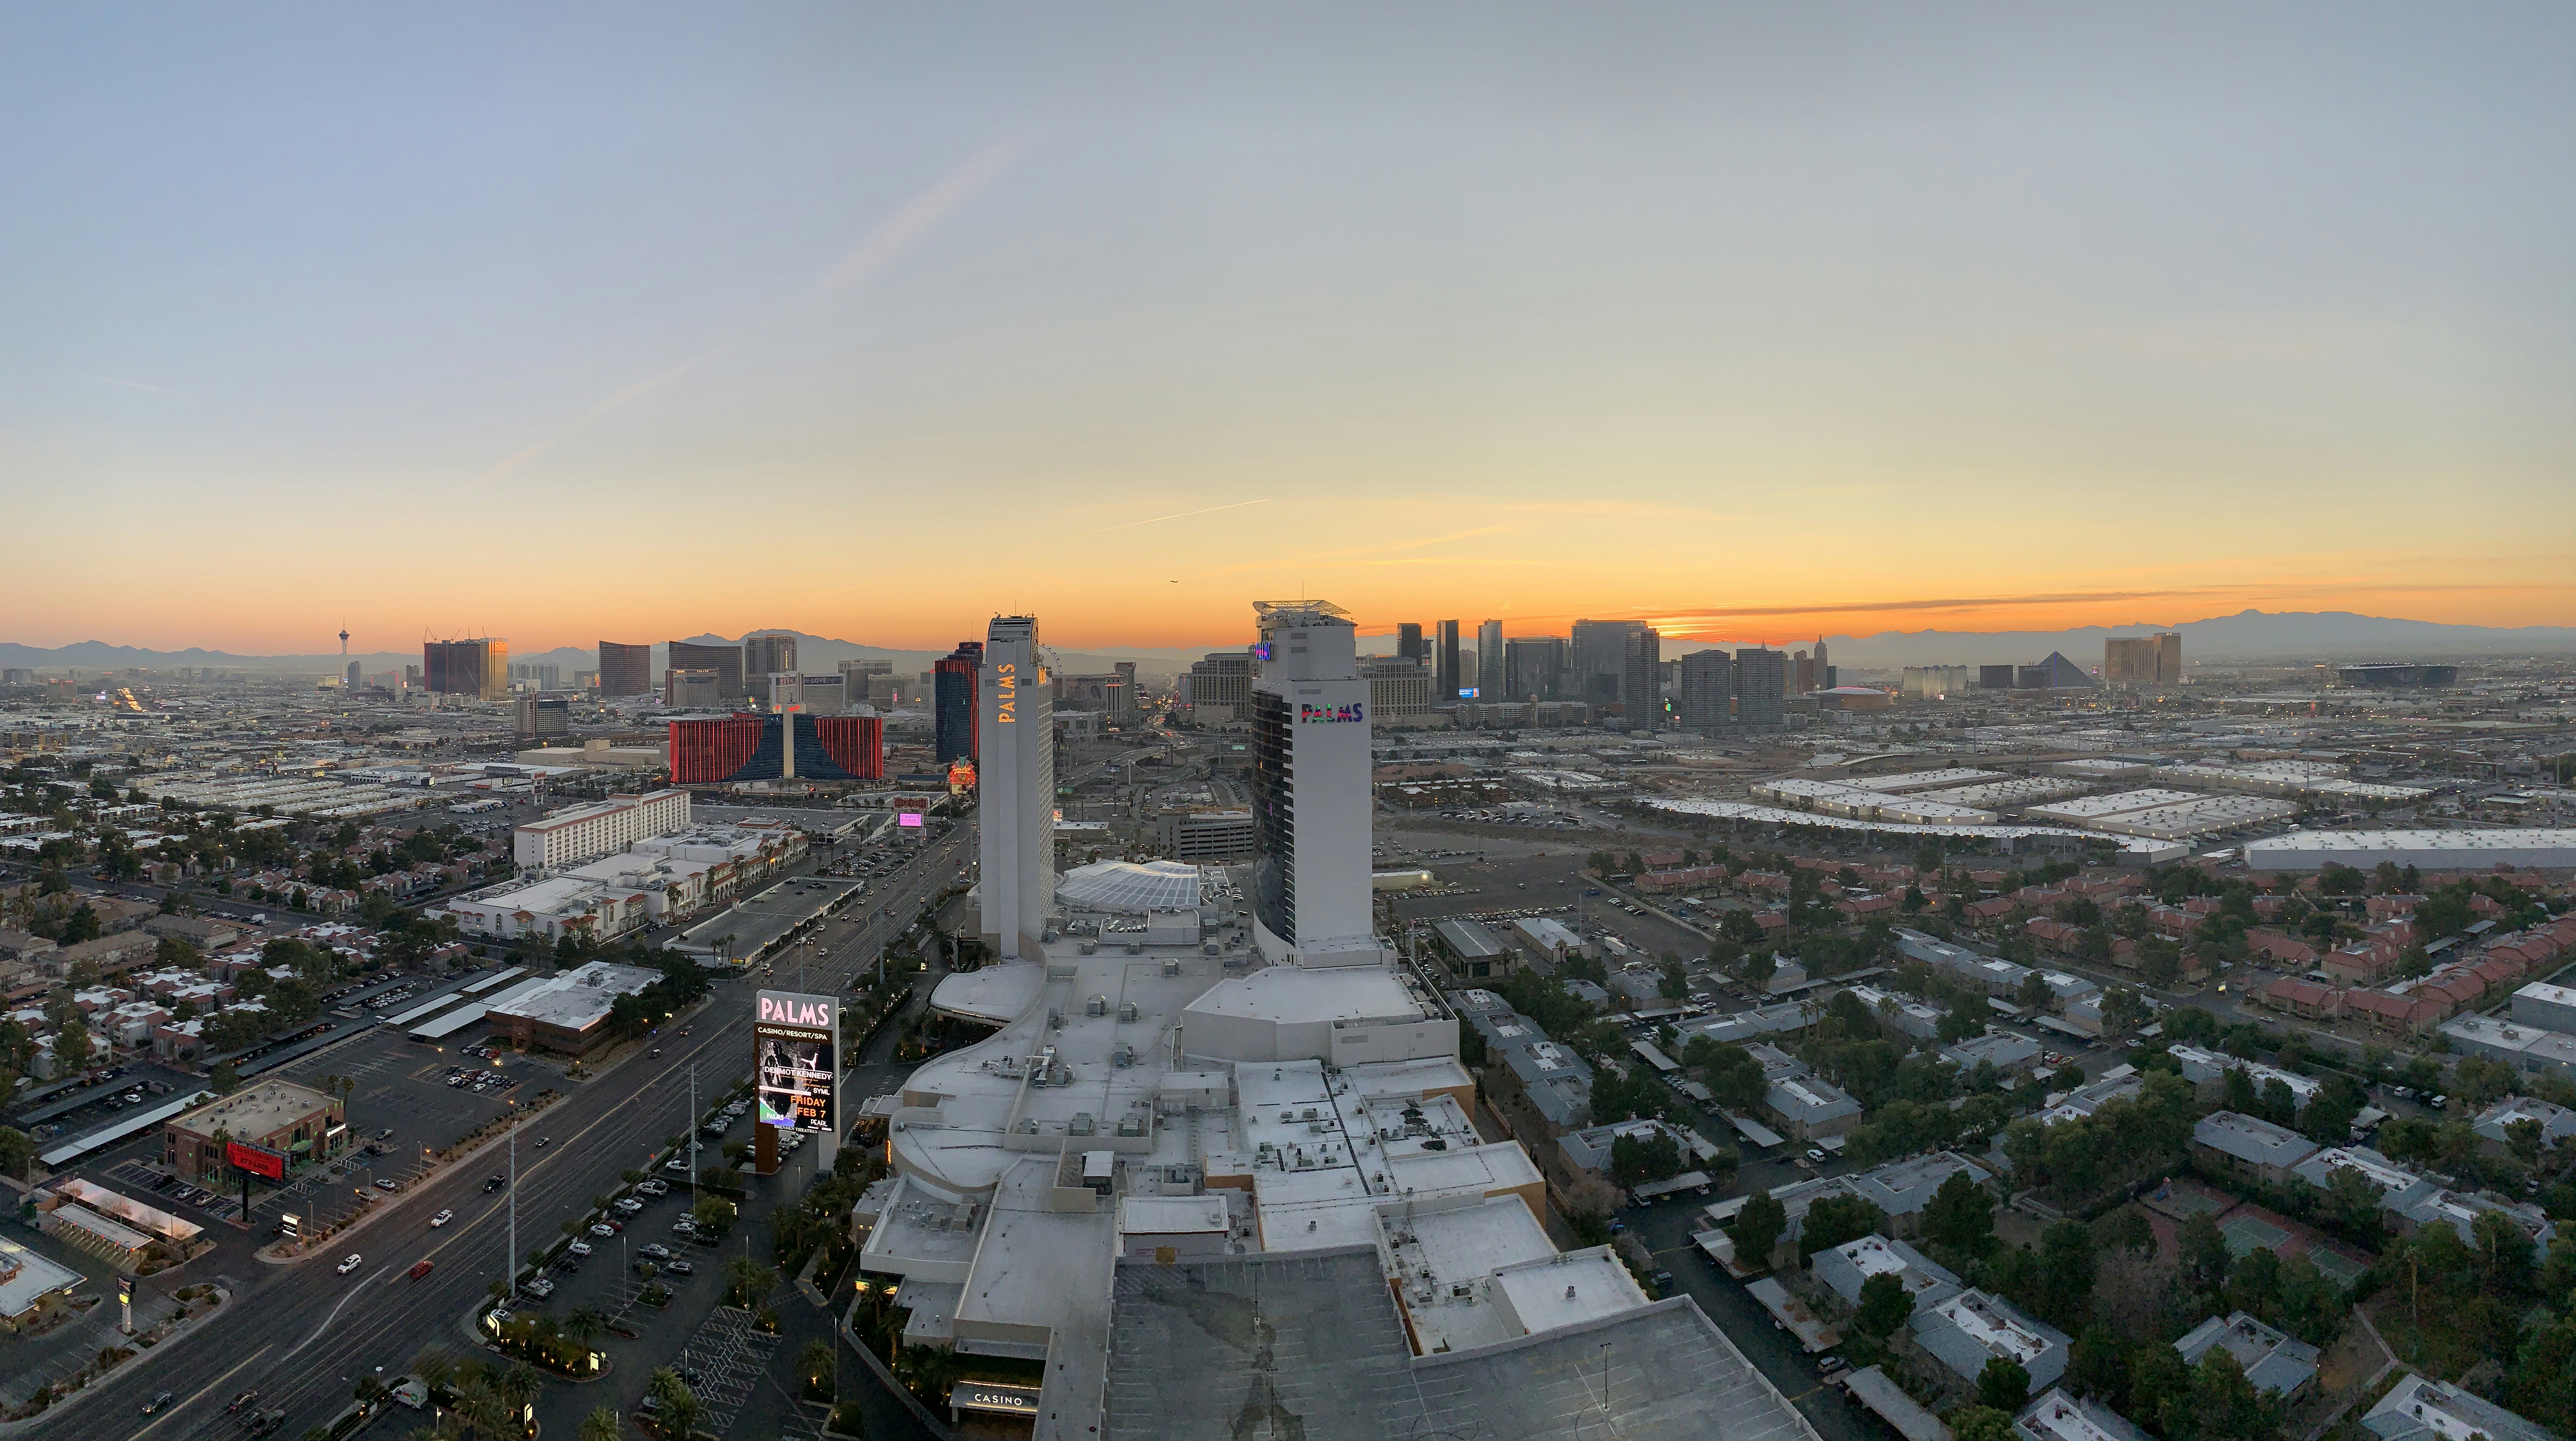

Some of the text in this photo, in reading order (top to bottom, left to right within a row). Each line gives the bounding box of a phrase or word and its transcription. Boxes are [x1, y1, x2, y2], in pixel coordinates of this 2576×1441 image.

[998, 663, 1016, 723] PALMS
[1302, 702, 1363, 723] PALMS
[762, 998, 829, 1026] PALMS
[764, 1066, 795, 1076] DERMOT
[797, 1070, 832, 1080] KENNEDY
[790, 1095, 826, 1107] FRIDAY
[767, 1112, 784, 1121] PALMS
[797, 1107, 816, 1117] FEB
[975, 1393, 1022, 1406] CASINO
